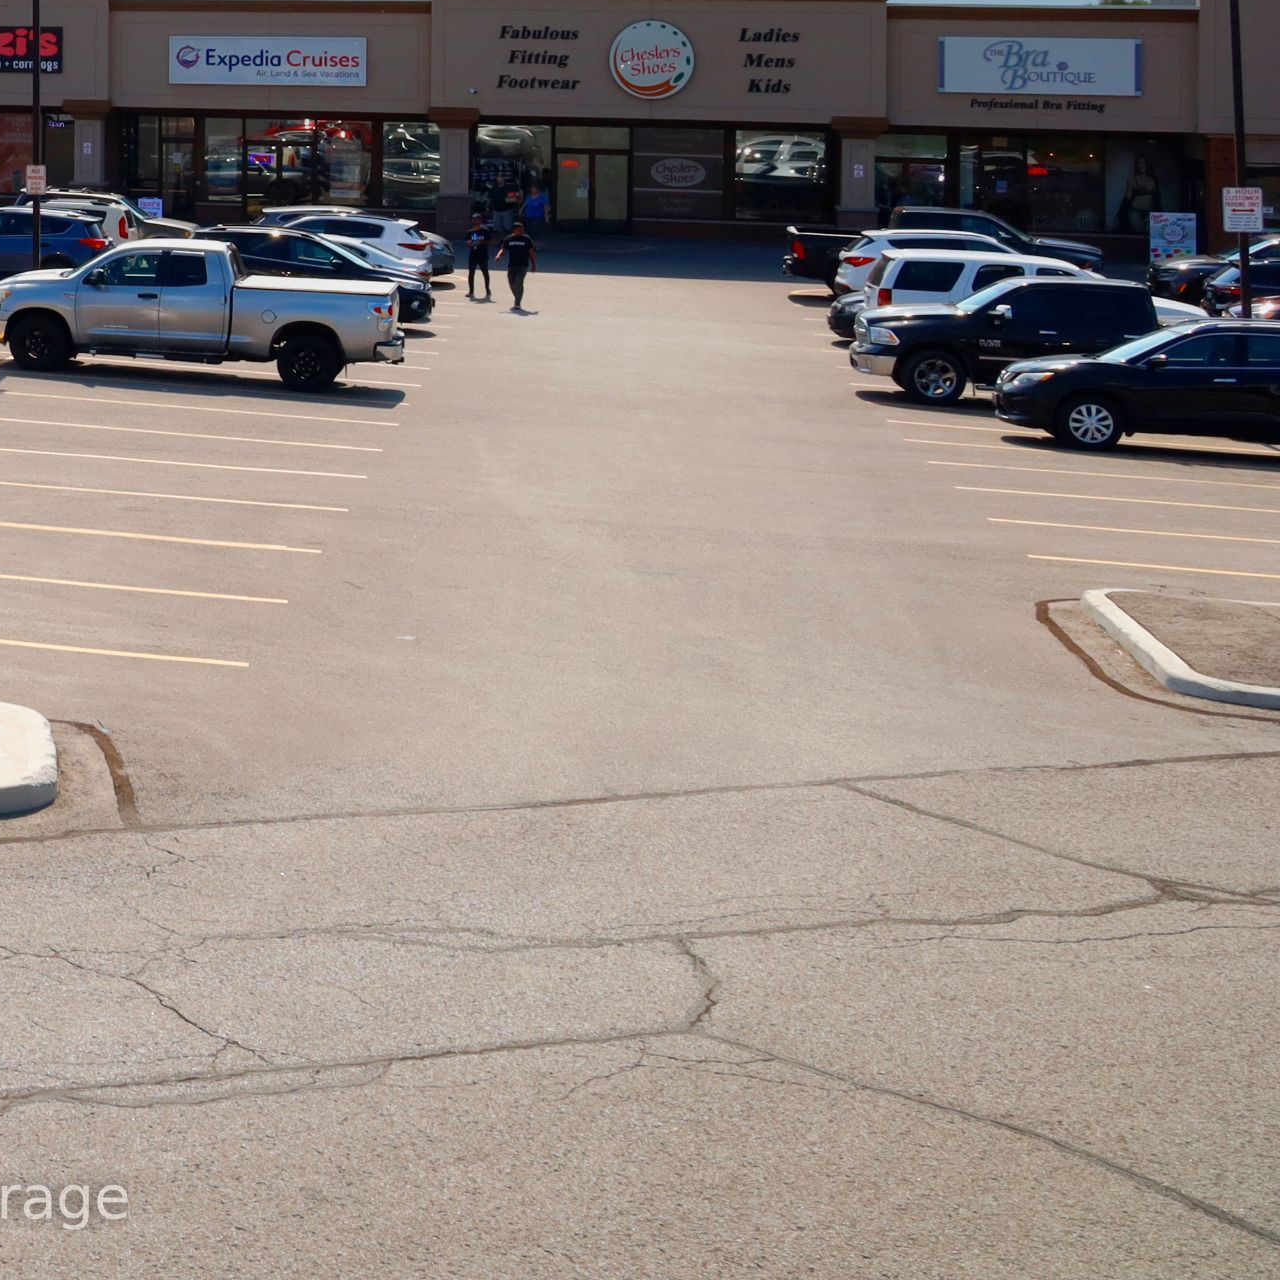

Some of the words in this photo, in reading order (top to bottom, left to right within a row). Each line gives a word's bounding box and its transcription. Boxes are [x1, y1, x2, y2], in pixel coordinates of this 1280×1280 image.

[499, 25, 579, 41] Fabulous
[738, 28, 800, 43] Ladies
[205, 48, 282, 72] Expedia
[287, 49, 360, 68] Cruises
[508, 50, 569, 68] Fitting
[620, 45, 682, 64] Cheslers
[990, 49, 1005, 57] THE
[630, 60, 678, 77] Shoes
[743, 53, 795, 69] Mens
[256, 70, 268, 78] Air,
[319, 70, 360, 78] Vacations
[496, 75, 580, 90] Footwear
[747, 78, 791, 93] Kids
[970, 99, 1039, 111] Professional
[1042, 100, 1062, 110] Bra
[1066, 100, 1106, 113] Fitting
